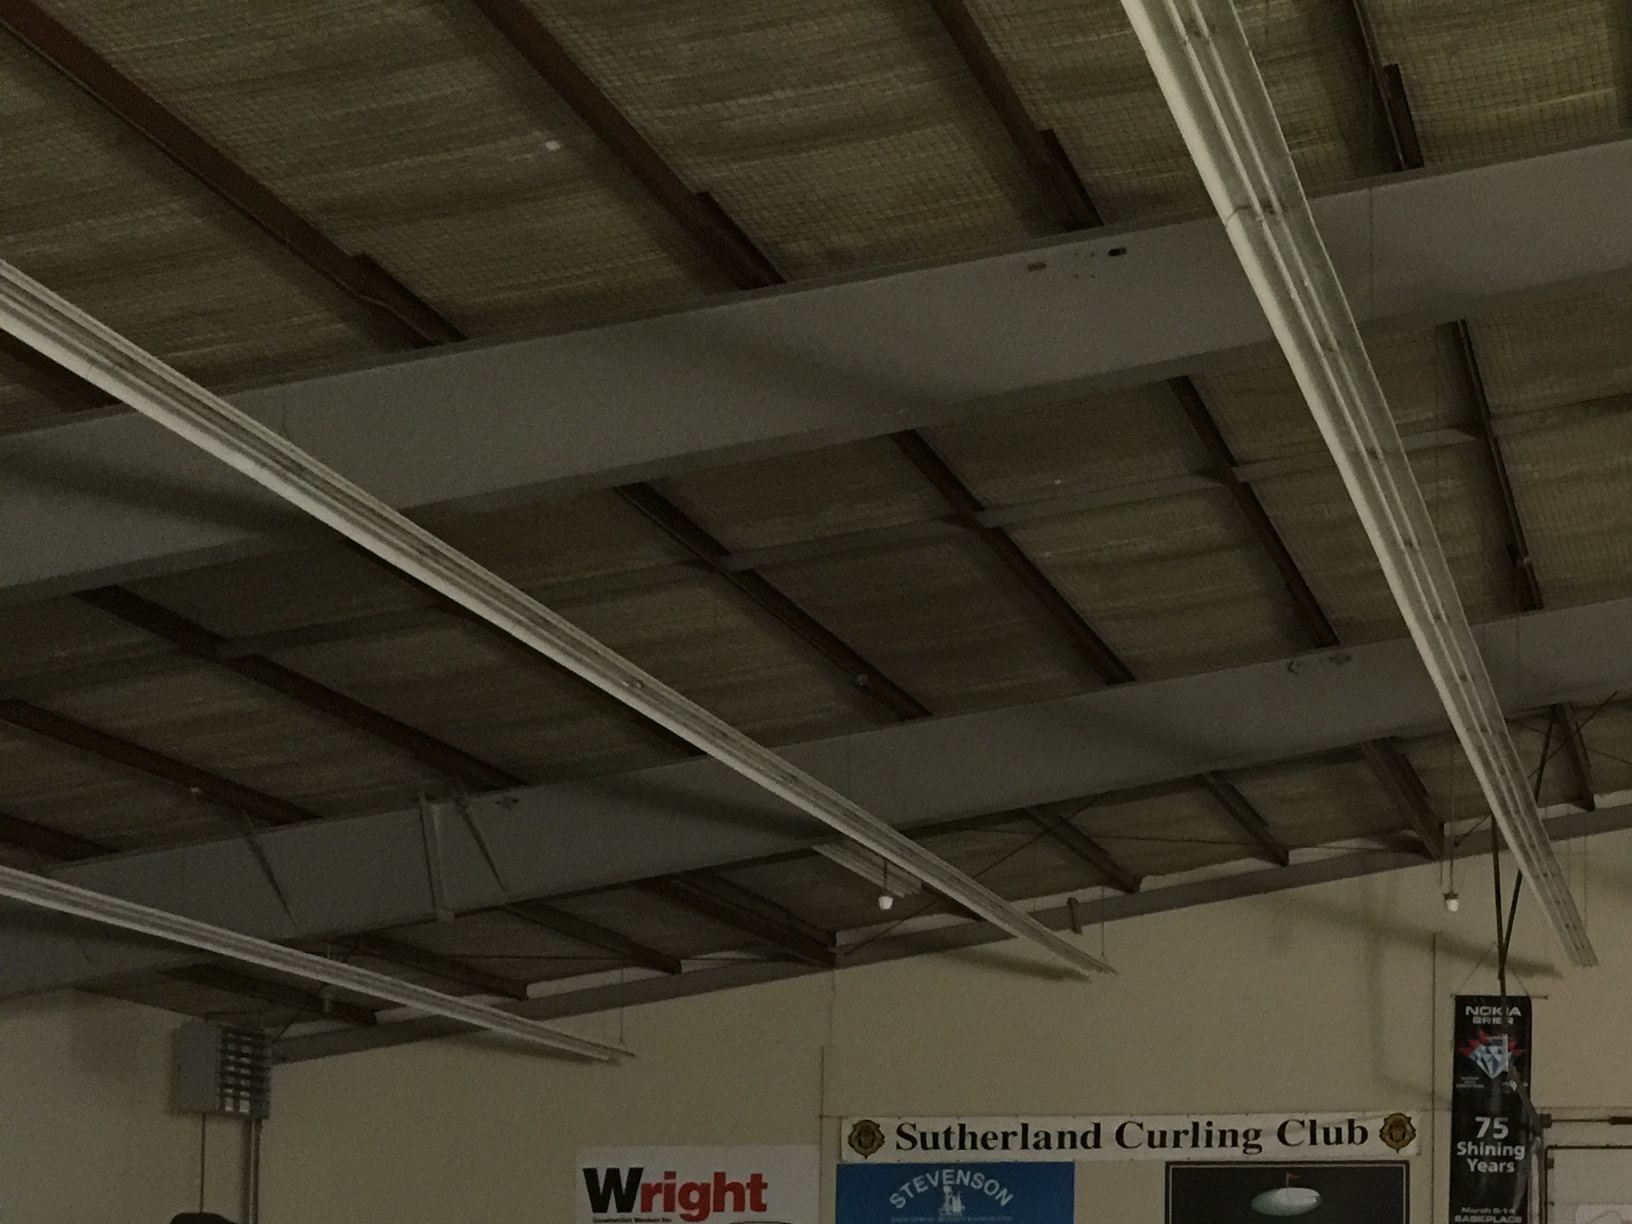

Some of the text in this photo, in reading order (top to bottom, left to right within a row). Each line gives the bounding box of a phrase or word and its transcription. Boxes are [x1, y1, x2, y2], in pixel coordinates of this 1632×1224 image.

[1465, 1006, 1521, 1016] NOKIA
[895, 1118, 1369, 1155] Sutherland Curling Club
[1474, 1116, 1509, 1140] 75
[1456, 1141, 1525, 1161] Shining
[1465, 1158, 1515, 1173] Years
[582, 1167, 768, 1222] Wright
[889, 1169, 1014, 1209] STEVENSON
